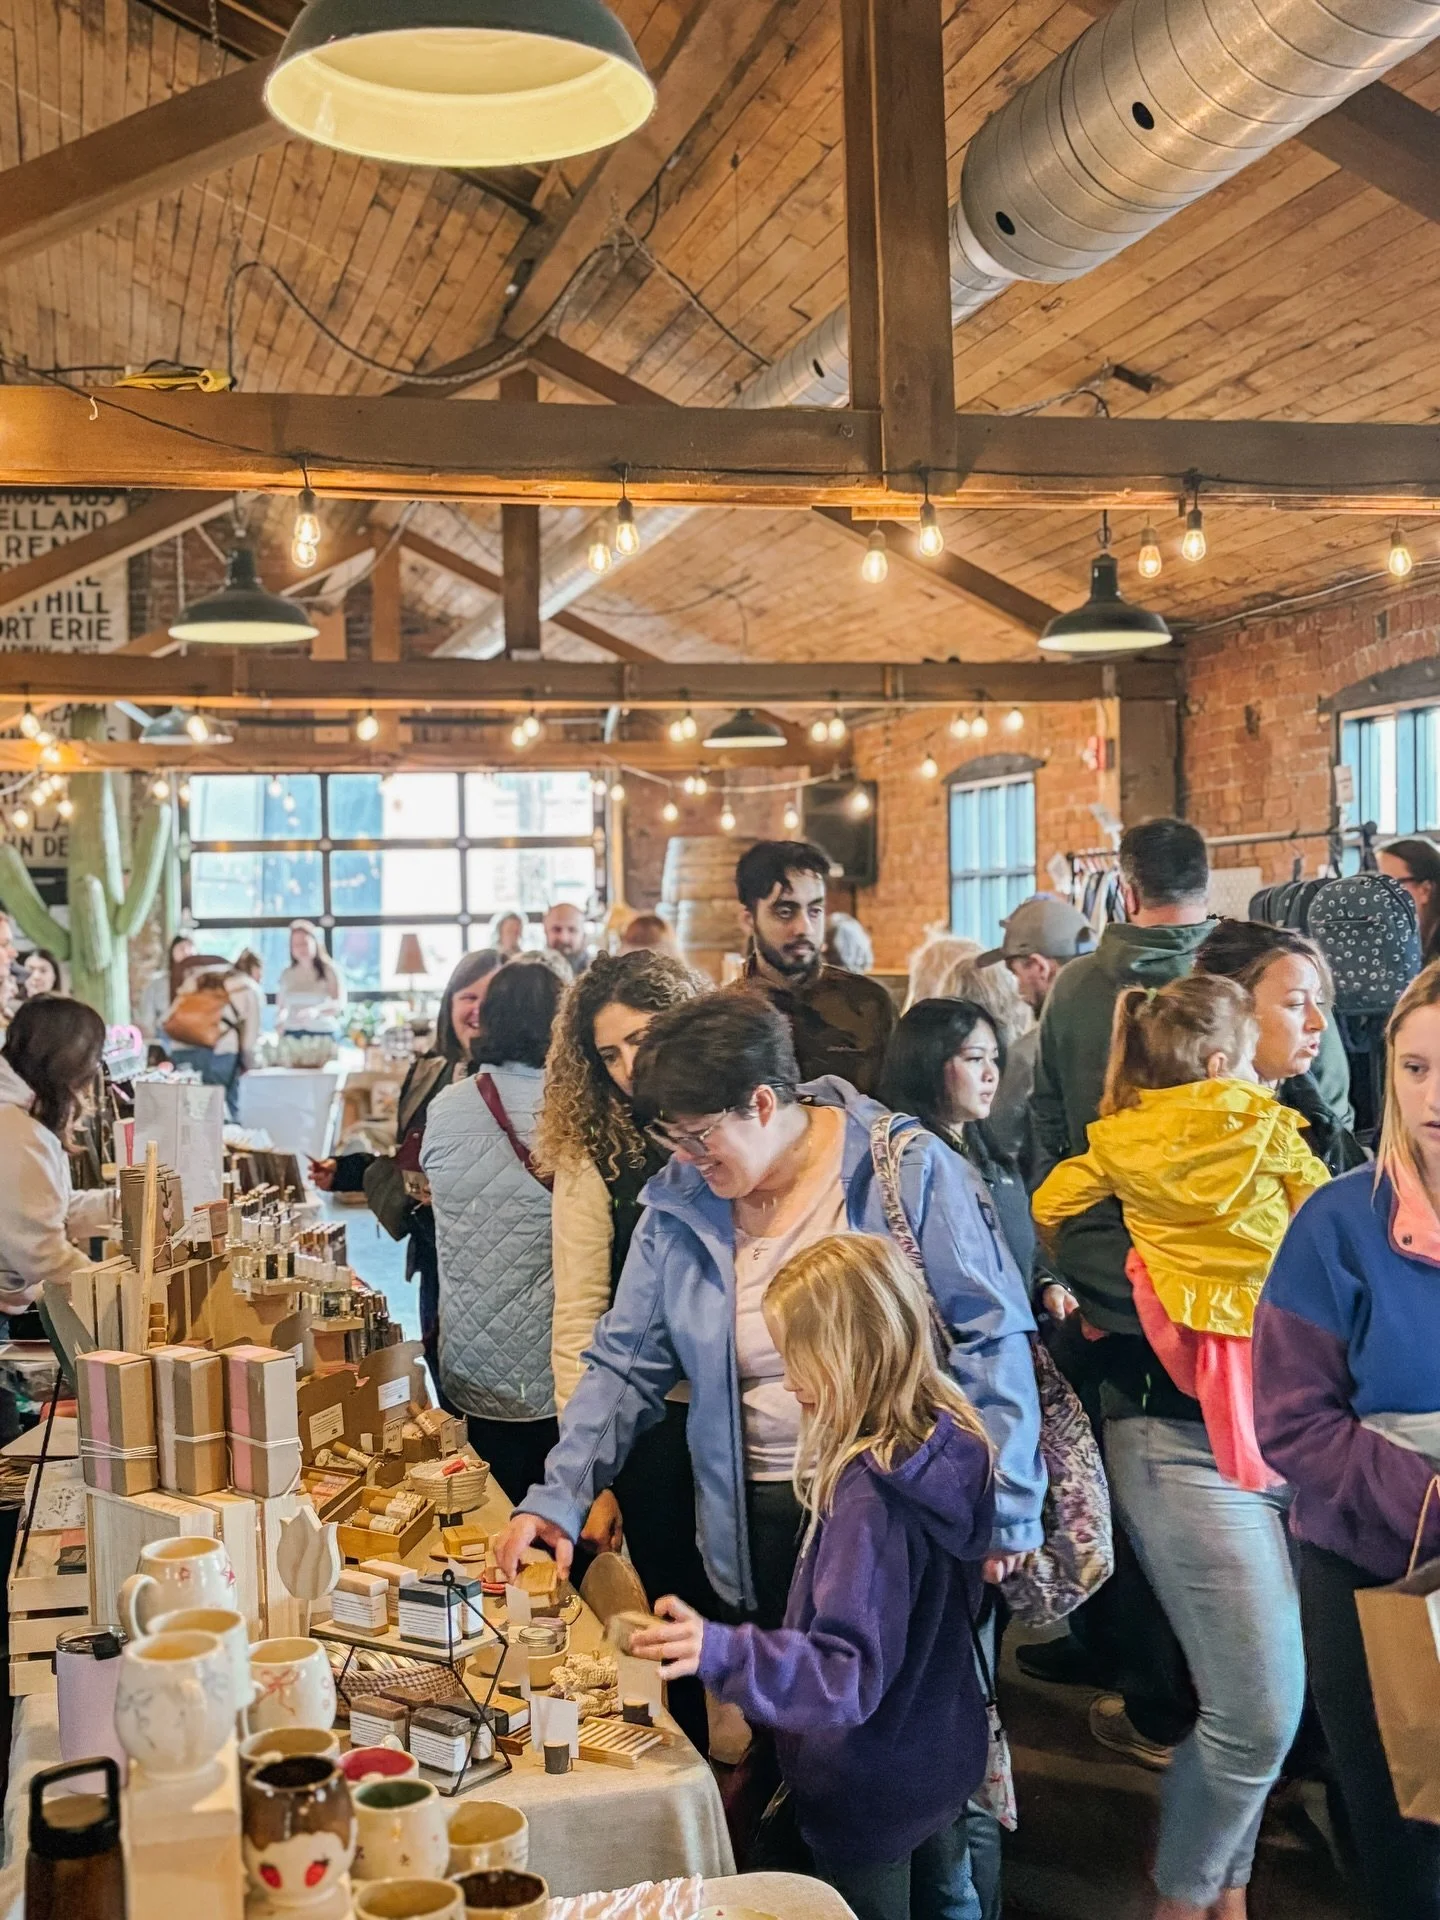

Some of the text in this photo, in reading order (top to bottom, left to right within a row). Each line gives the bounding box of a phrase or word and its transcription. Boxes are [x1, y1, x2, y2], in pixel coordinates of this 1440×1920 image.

[19, 590, 110, 613] HILL
[0, 616, 113, 641] RT ERIE
